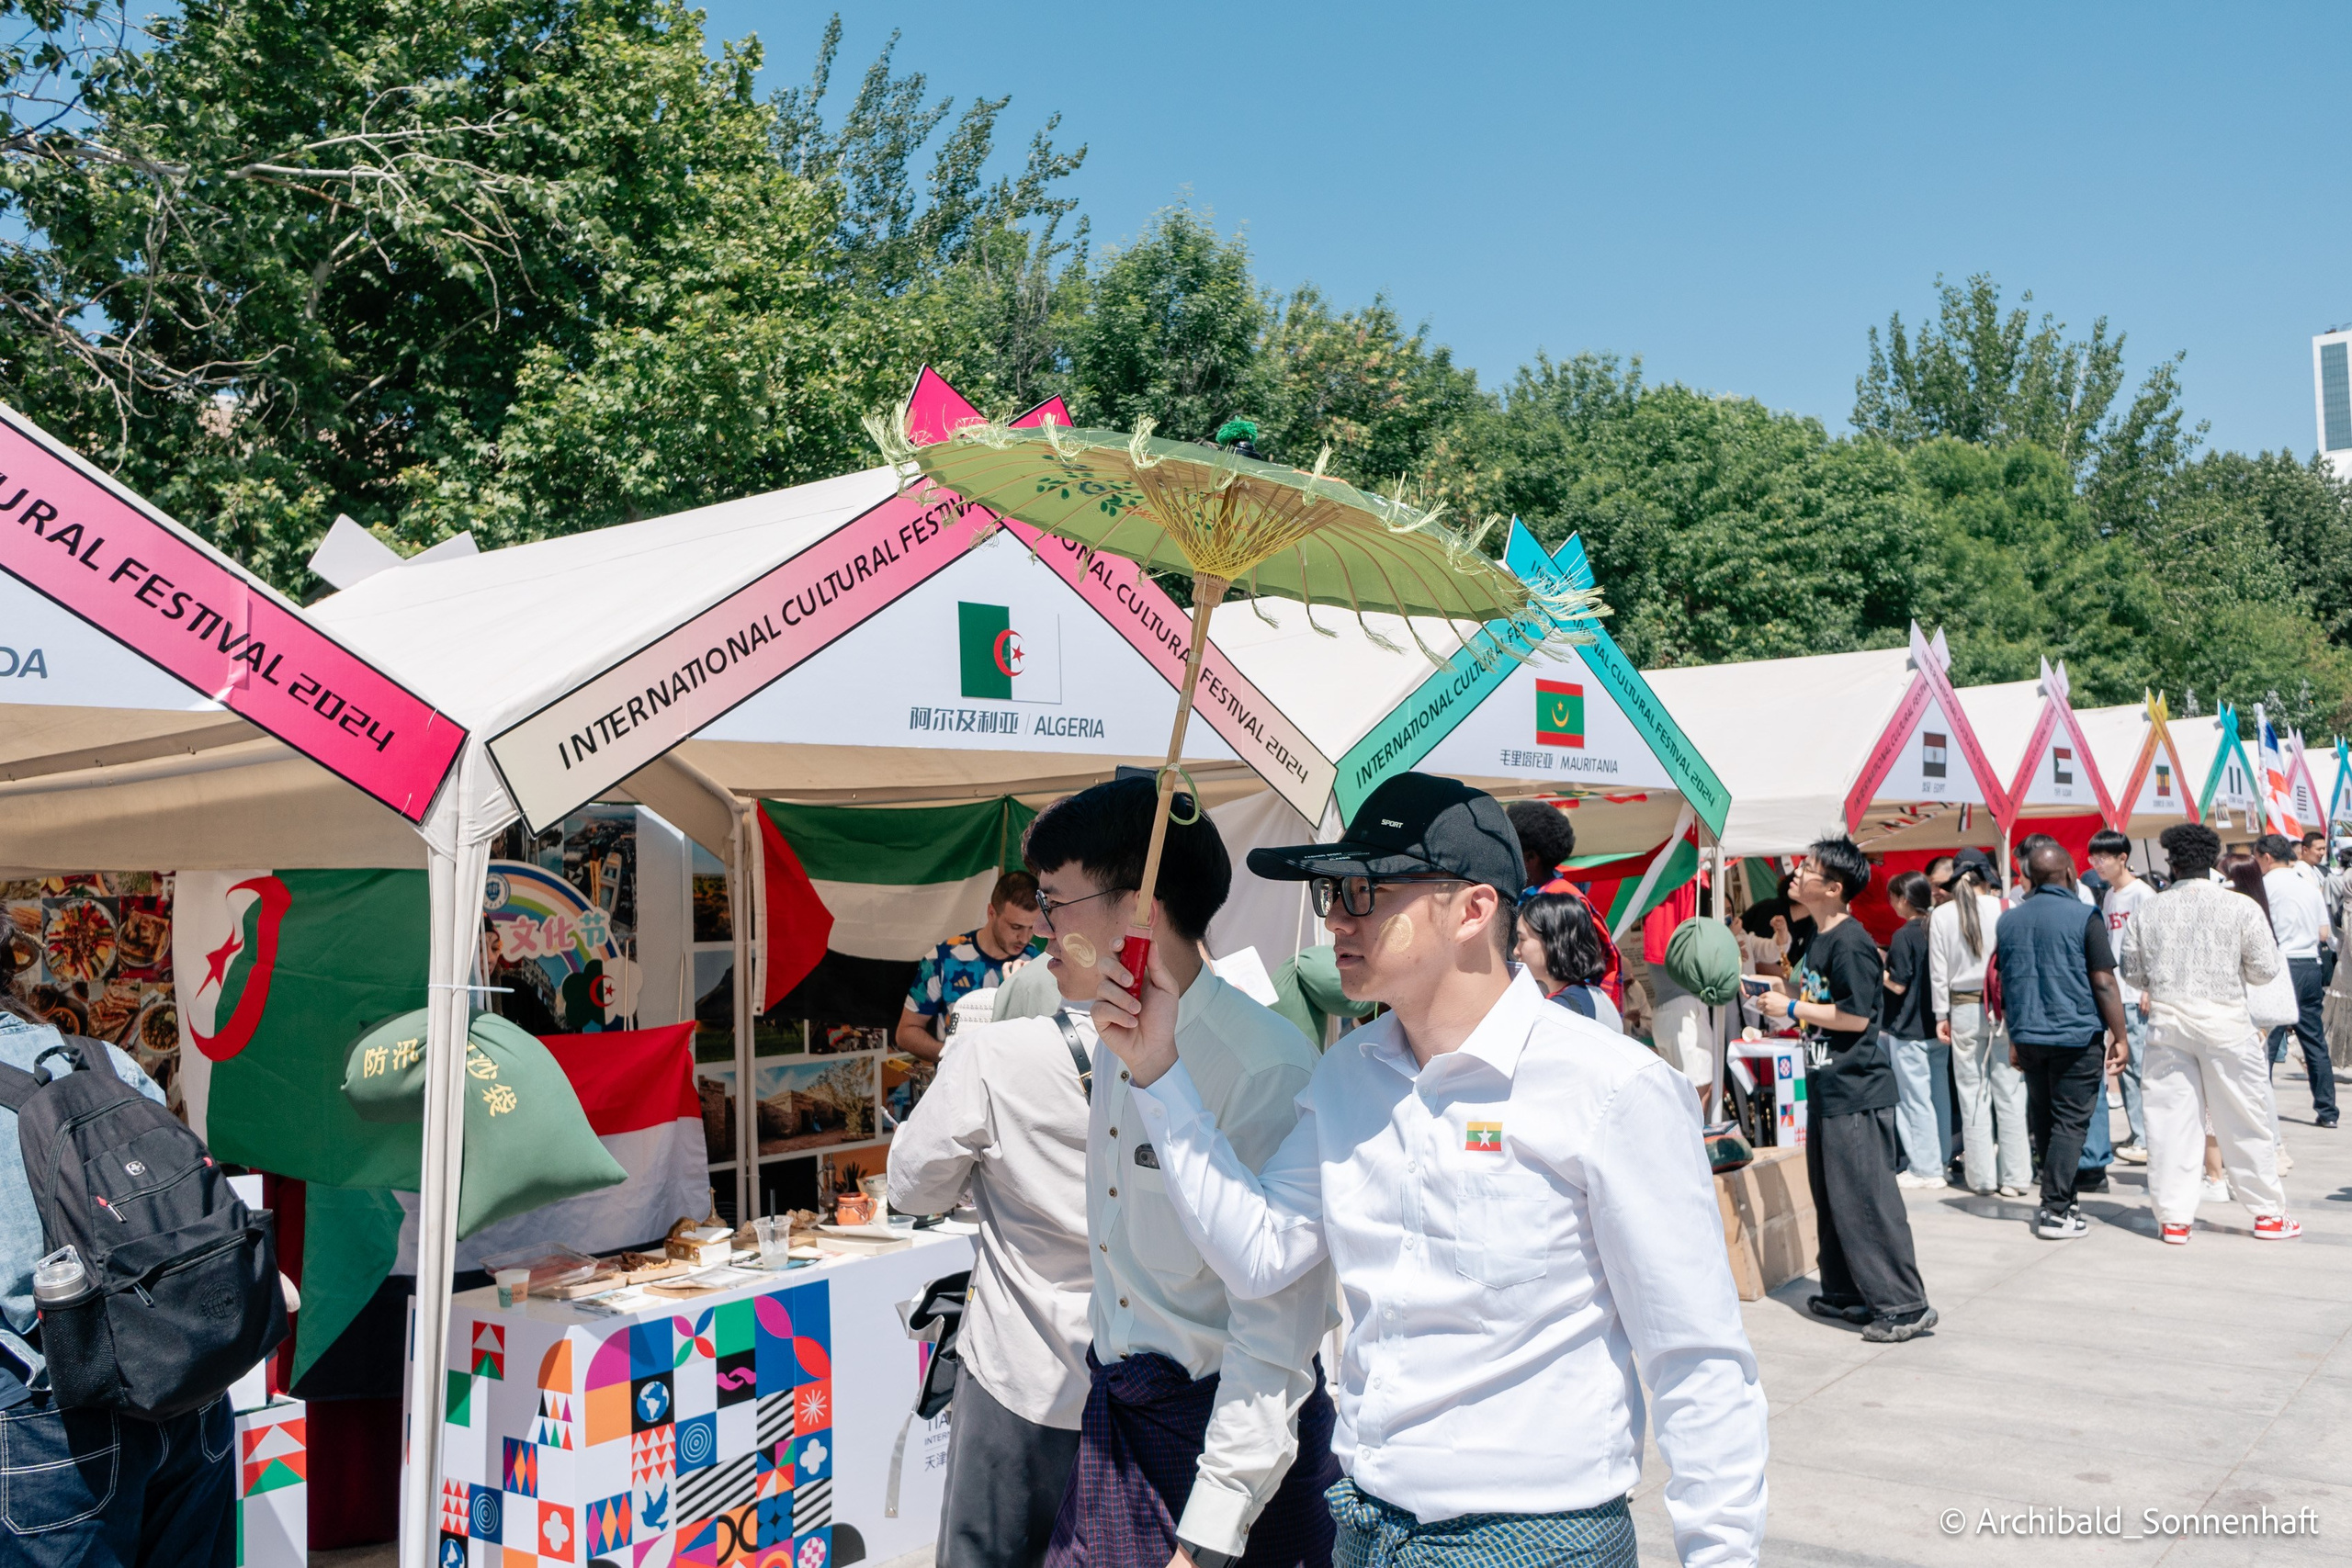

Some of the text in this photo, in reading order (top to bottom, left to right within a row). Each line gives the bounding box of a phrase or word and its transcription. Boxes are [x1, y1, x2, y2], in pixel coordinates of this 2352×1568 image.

[0, 472, 395, 752] URAL FESTIVAL 2024
[558, 614, 782, 771] INTERNATIONAL
[782, 538, 900, 626] CULTURAL
[1117, 583, 1191, 667] CULTURA
[1199, 667, 1264, 744] FESTIVAL
[1265, 735, 1308, 784] 2024
[910, 707, 1019, 734] 阿尔及利亚
[1034, 716, 1105, 739] ALGERIA
[1355, 689, 1454, 789] INTERNATIONAL
[1611, 663, 1654, 728] CULTURAL
[1655, 722, 1690, 777] FESTIVAL
[1690, 771, 1715, 808] 2024
[1499, 750, 1553, 769] 毛里塔尼亚
[1560, 755, 1618, 773] MAURITANIA
[1381, 818, 1404, 829] SPORT
[495, 912, 606, 954] 文化节
